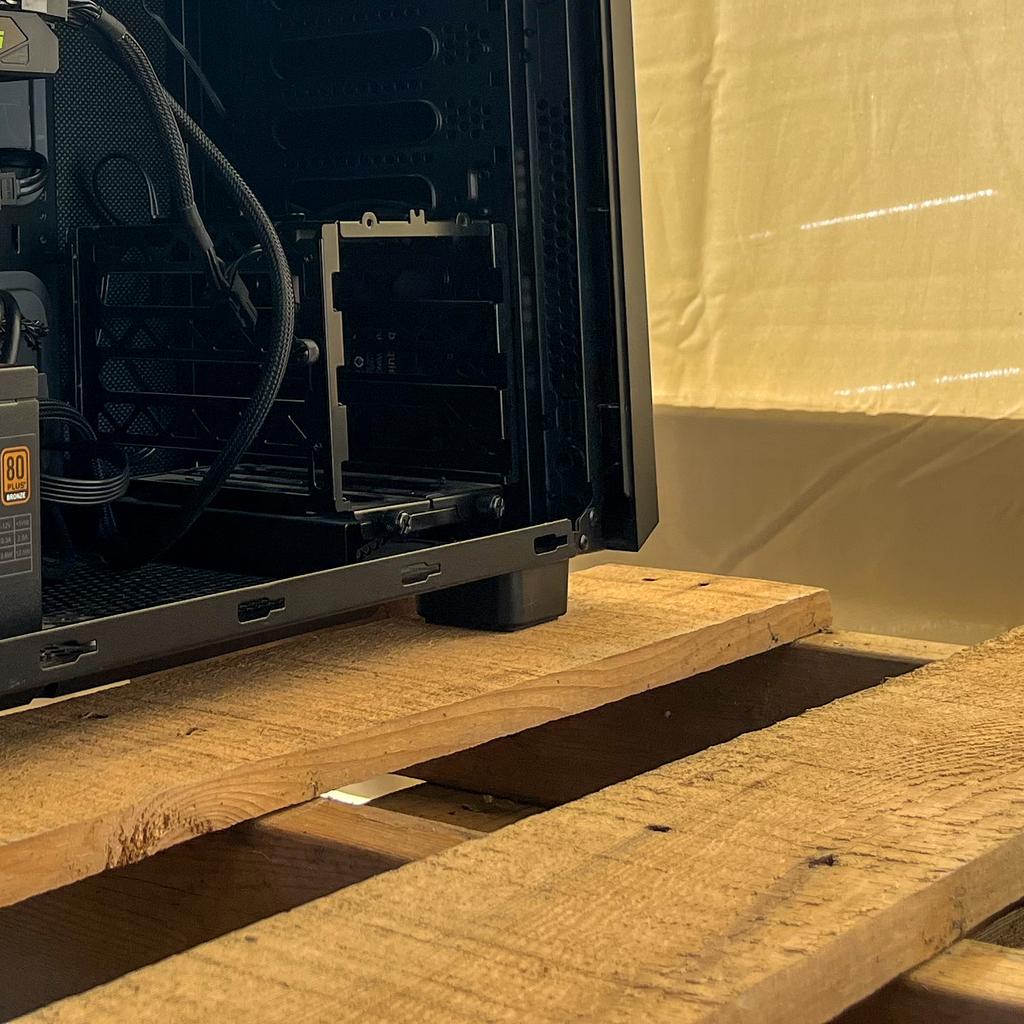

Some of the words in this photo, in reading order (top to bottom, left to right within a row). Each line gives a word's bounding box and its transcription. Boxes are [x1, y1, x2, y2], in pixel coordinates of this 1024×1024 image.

[6, 454, 25, 481] 80
[7, 481, 25, 491] PLUS
[6, 491, 26, 502] BRONZE
